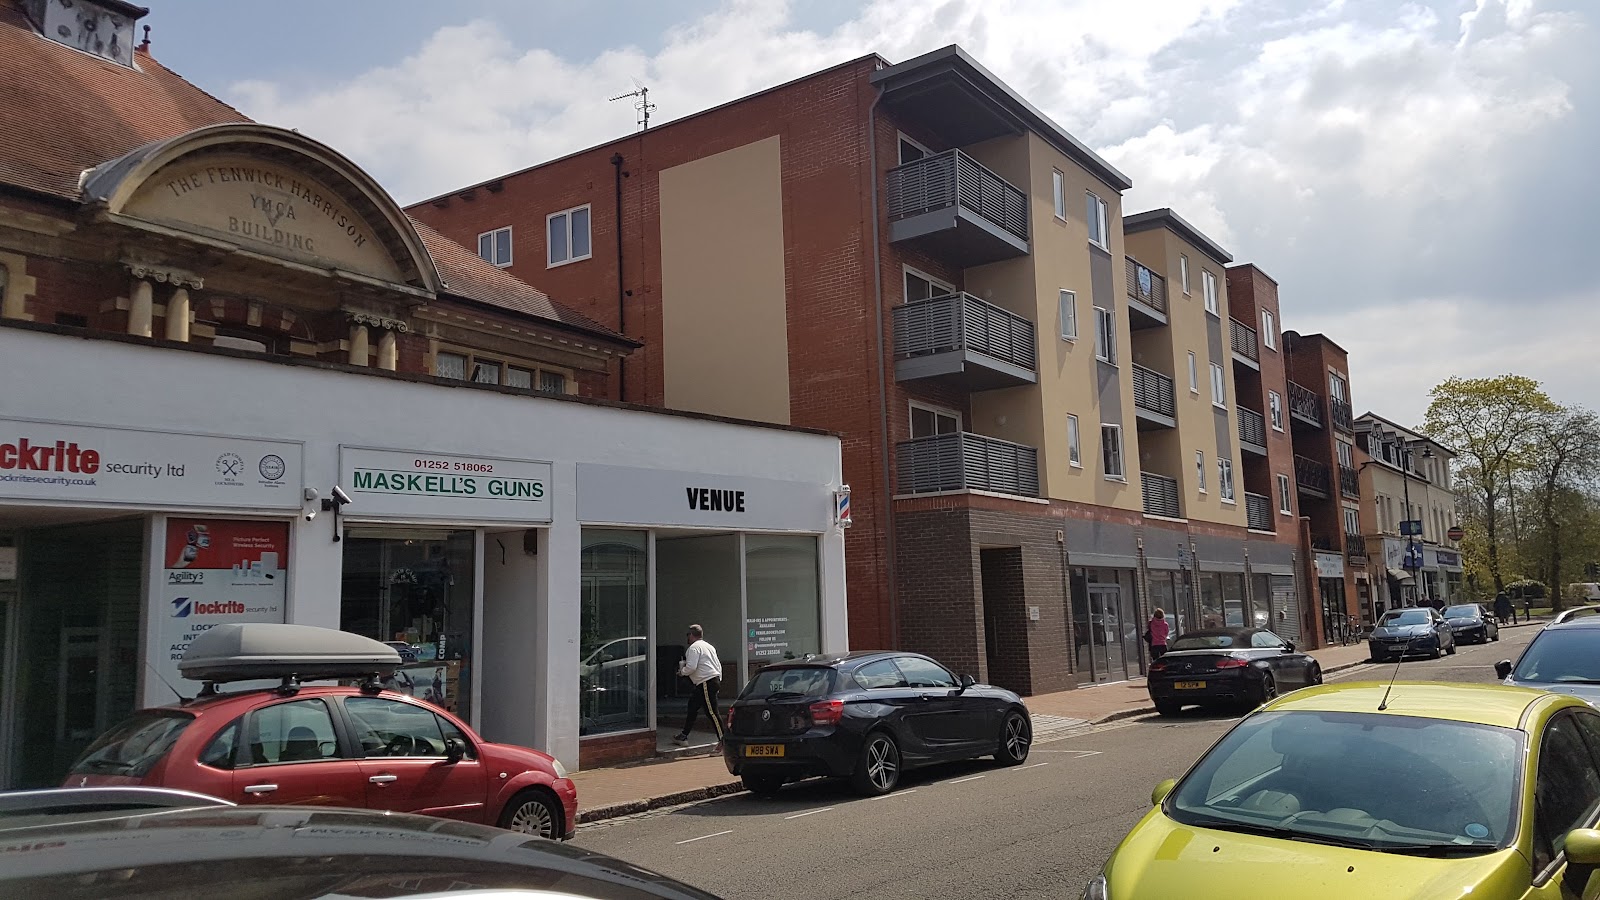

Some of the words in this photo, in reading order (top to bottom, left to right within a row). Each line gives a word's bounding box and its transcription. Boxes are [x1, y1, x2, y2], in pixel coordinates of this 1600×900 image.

[166, 173, 203, 197] THE
[207, 167, 283, 189] FENWICK
[290, 180, 367, 248] HARRISON
[250, 193, 296, 220] YMCA
[229, 216, 314, 251] BUILDING
[106, 462, 162, 479] security
[166, 463, 185, 477] ltd
[414, 459, 449, 470] 01252
[454, 462, 494, 473] 518062
[353, 471, 477, 494] MASKELL'S
[487, 479, 544, 498] GUNS
[686, 487, 745, 512] VENUE
[194, 601, 245, 614] lockrite
[246, 606, 268, 614] security
